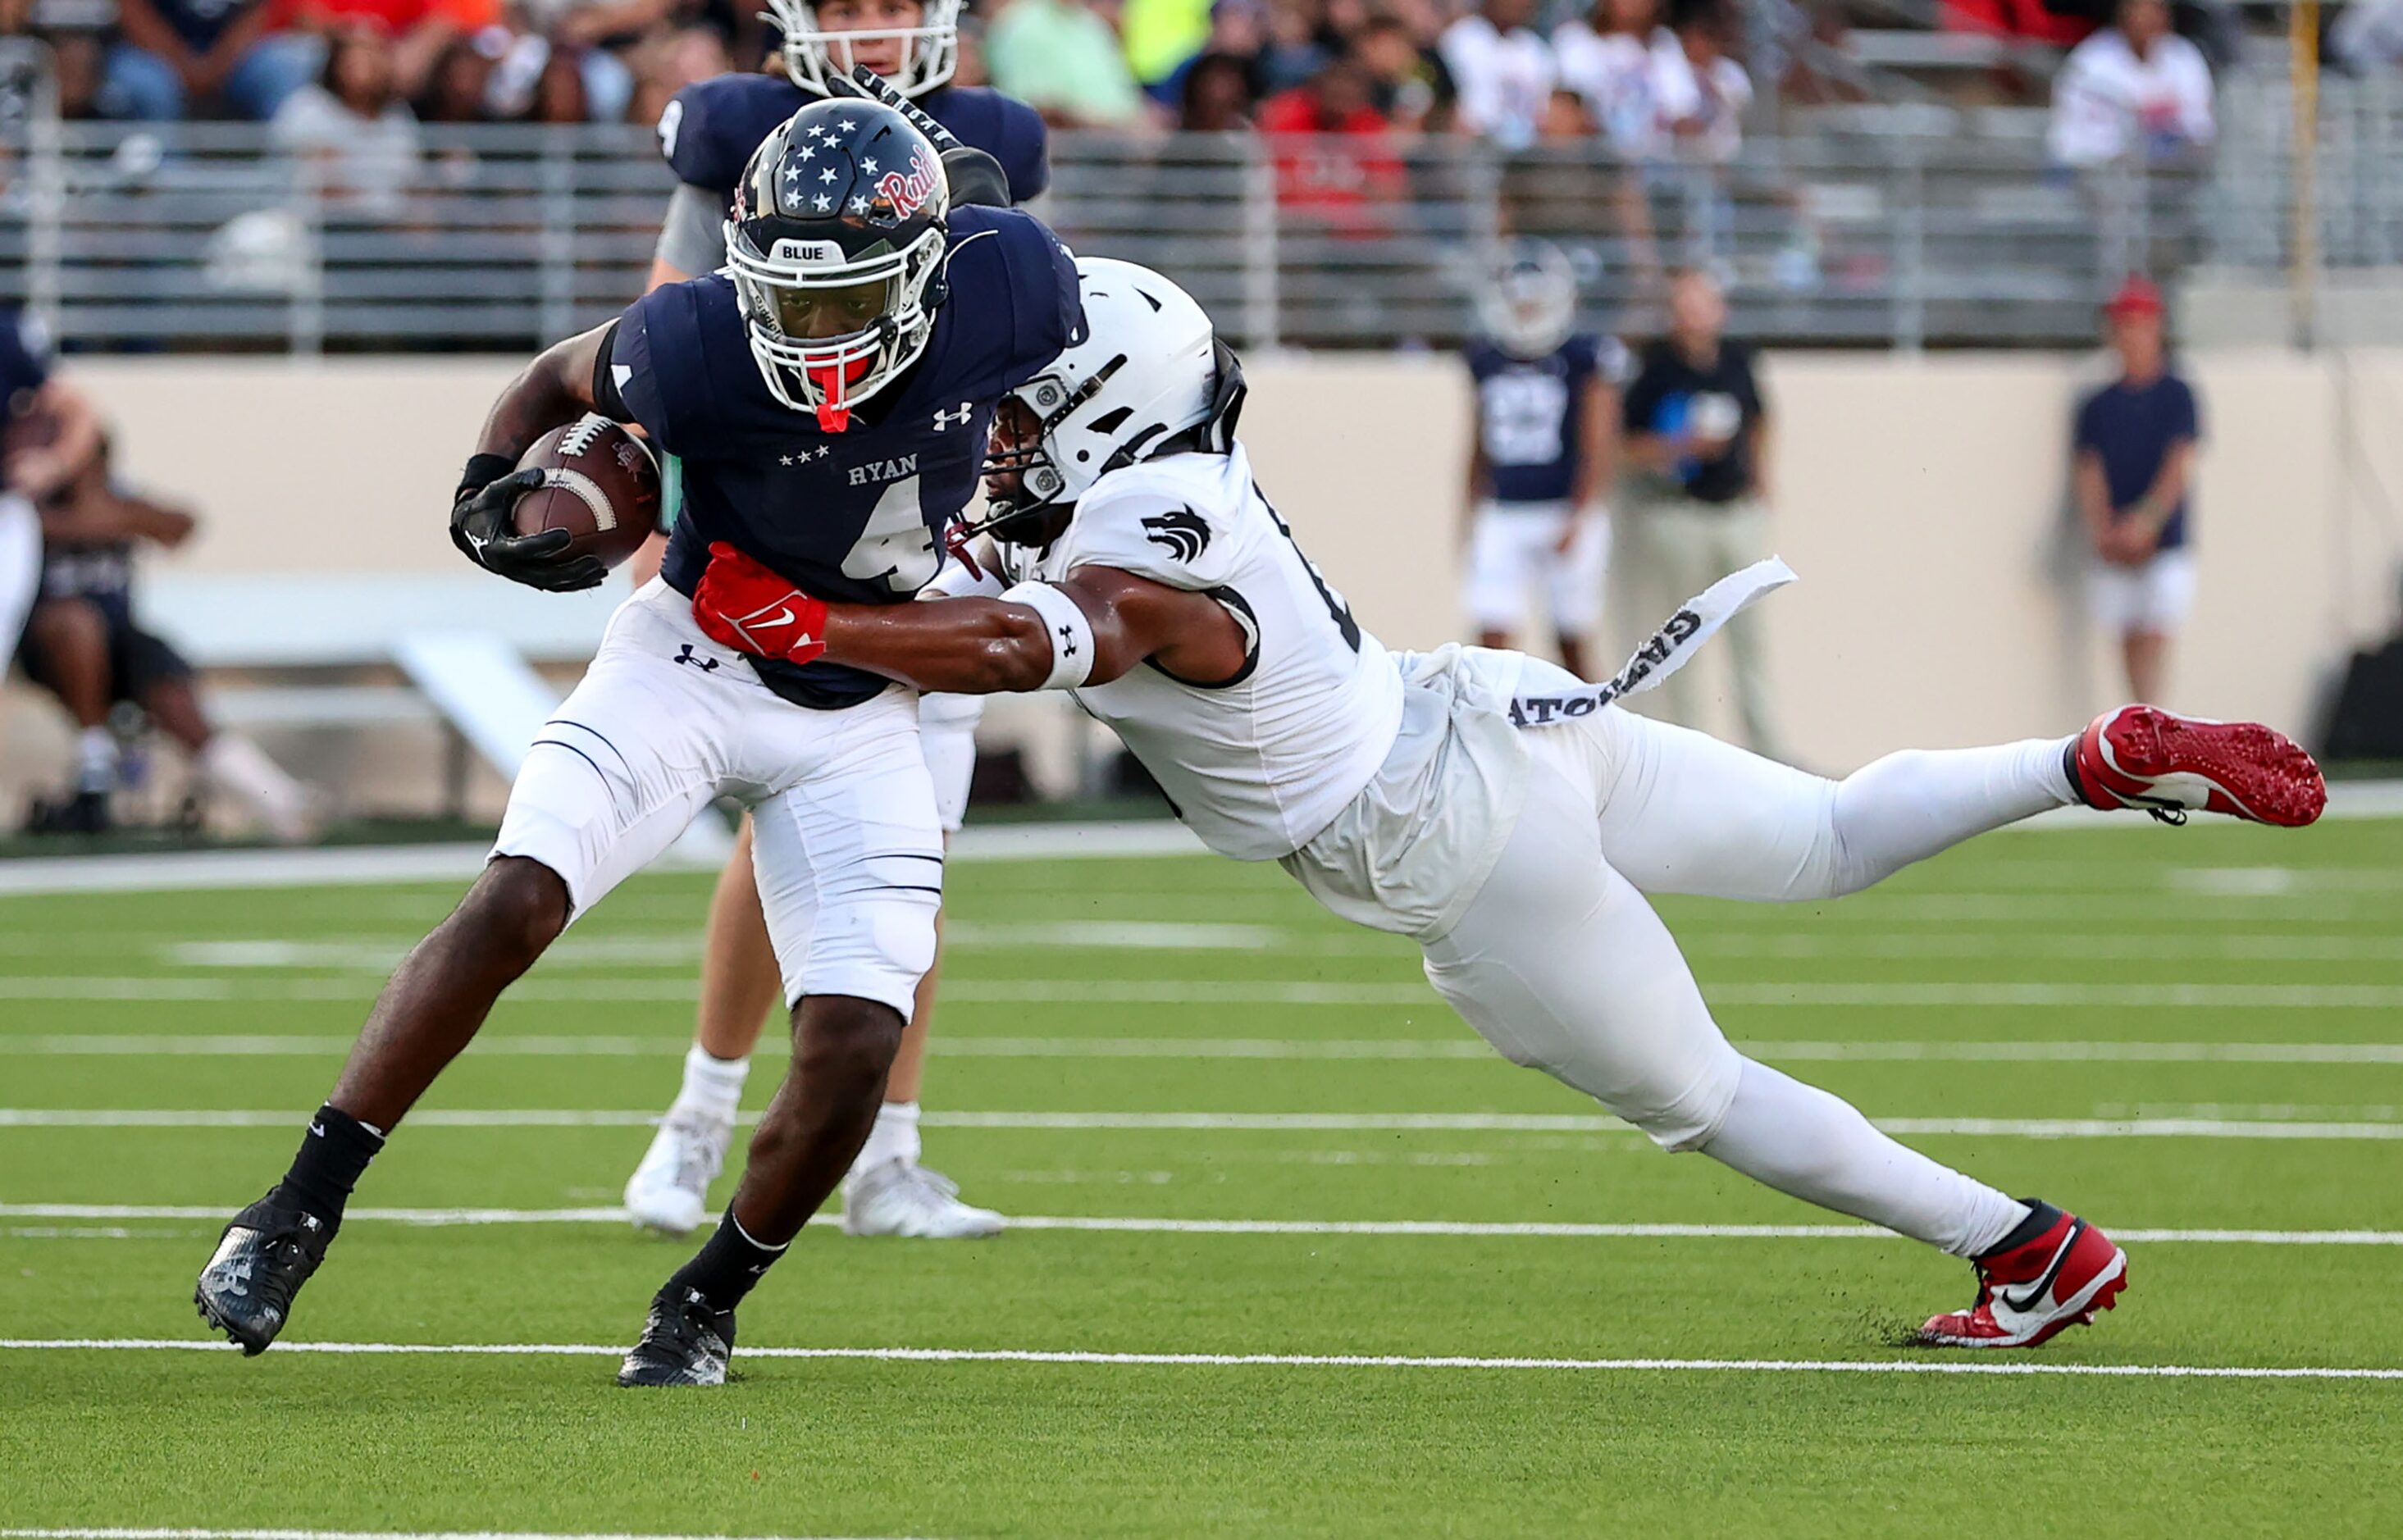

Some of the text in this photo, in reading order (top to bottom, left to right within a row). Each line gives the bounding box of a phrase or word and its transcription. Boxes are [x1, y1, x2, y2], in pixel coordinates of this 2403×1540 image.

[783, 246, 823, 260] BLUE
[848, 453, 918, 485] RYAN
[841, 473, 939, 592] 4
